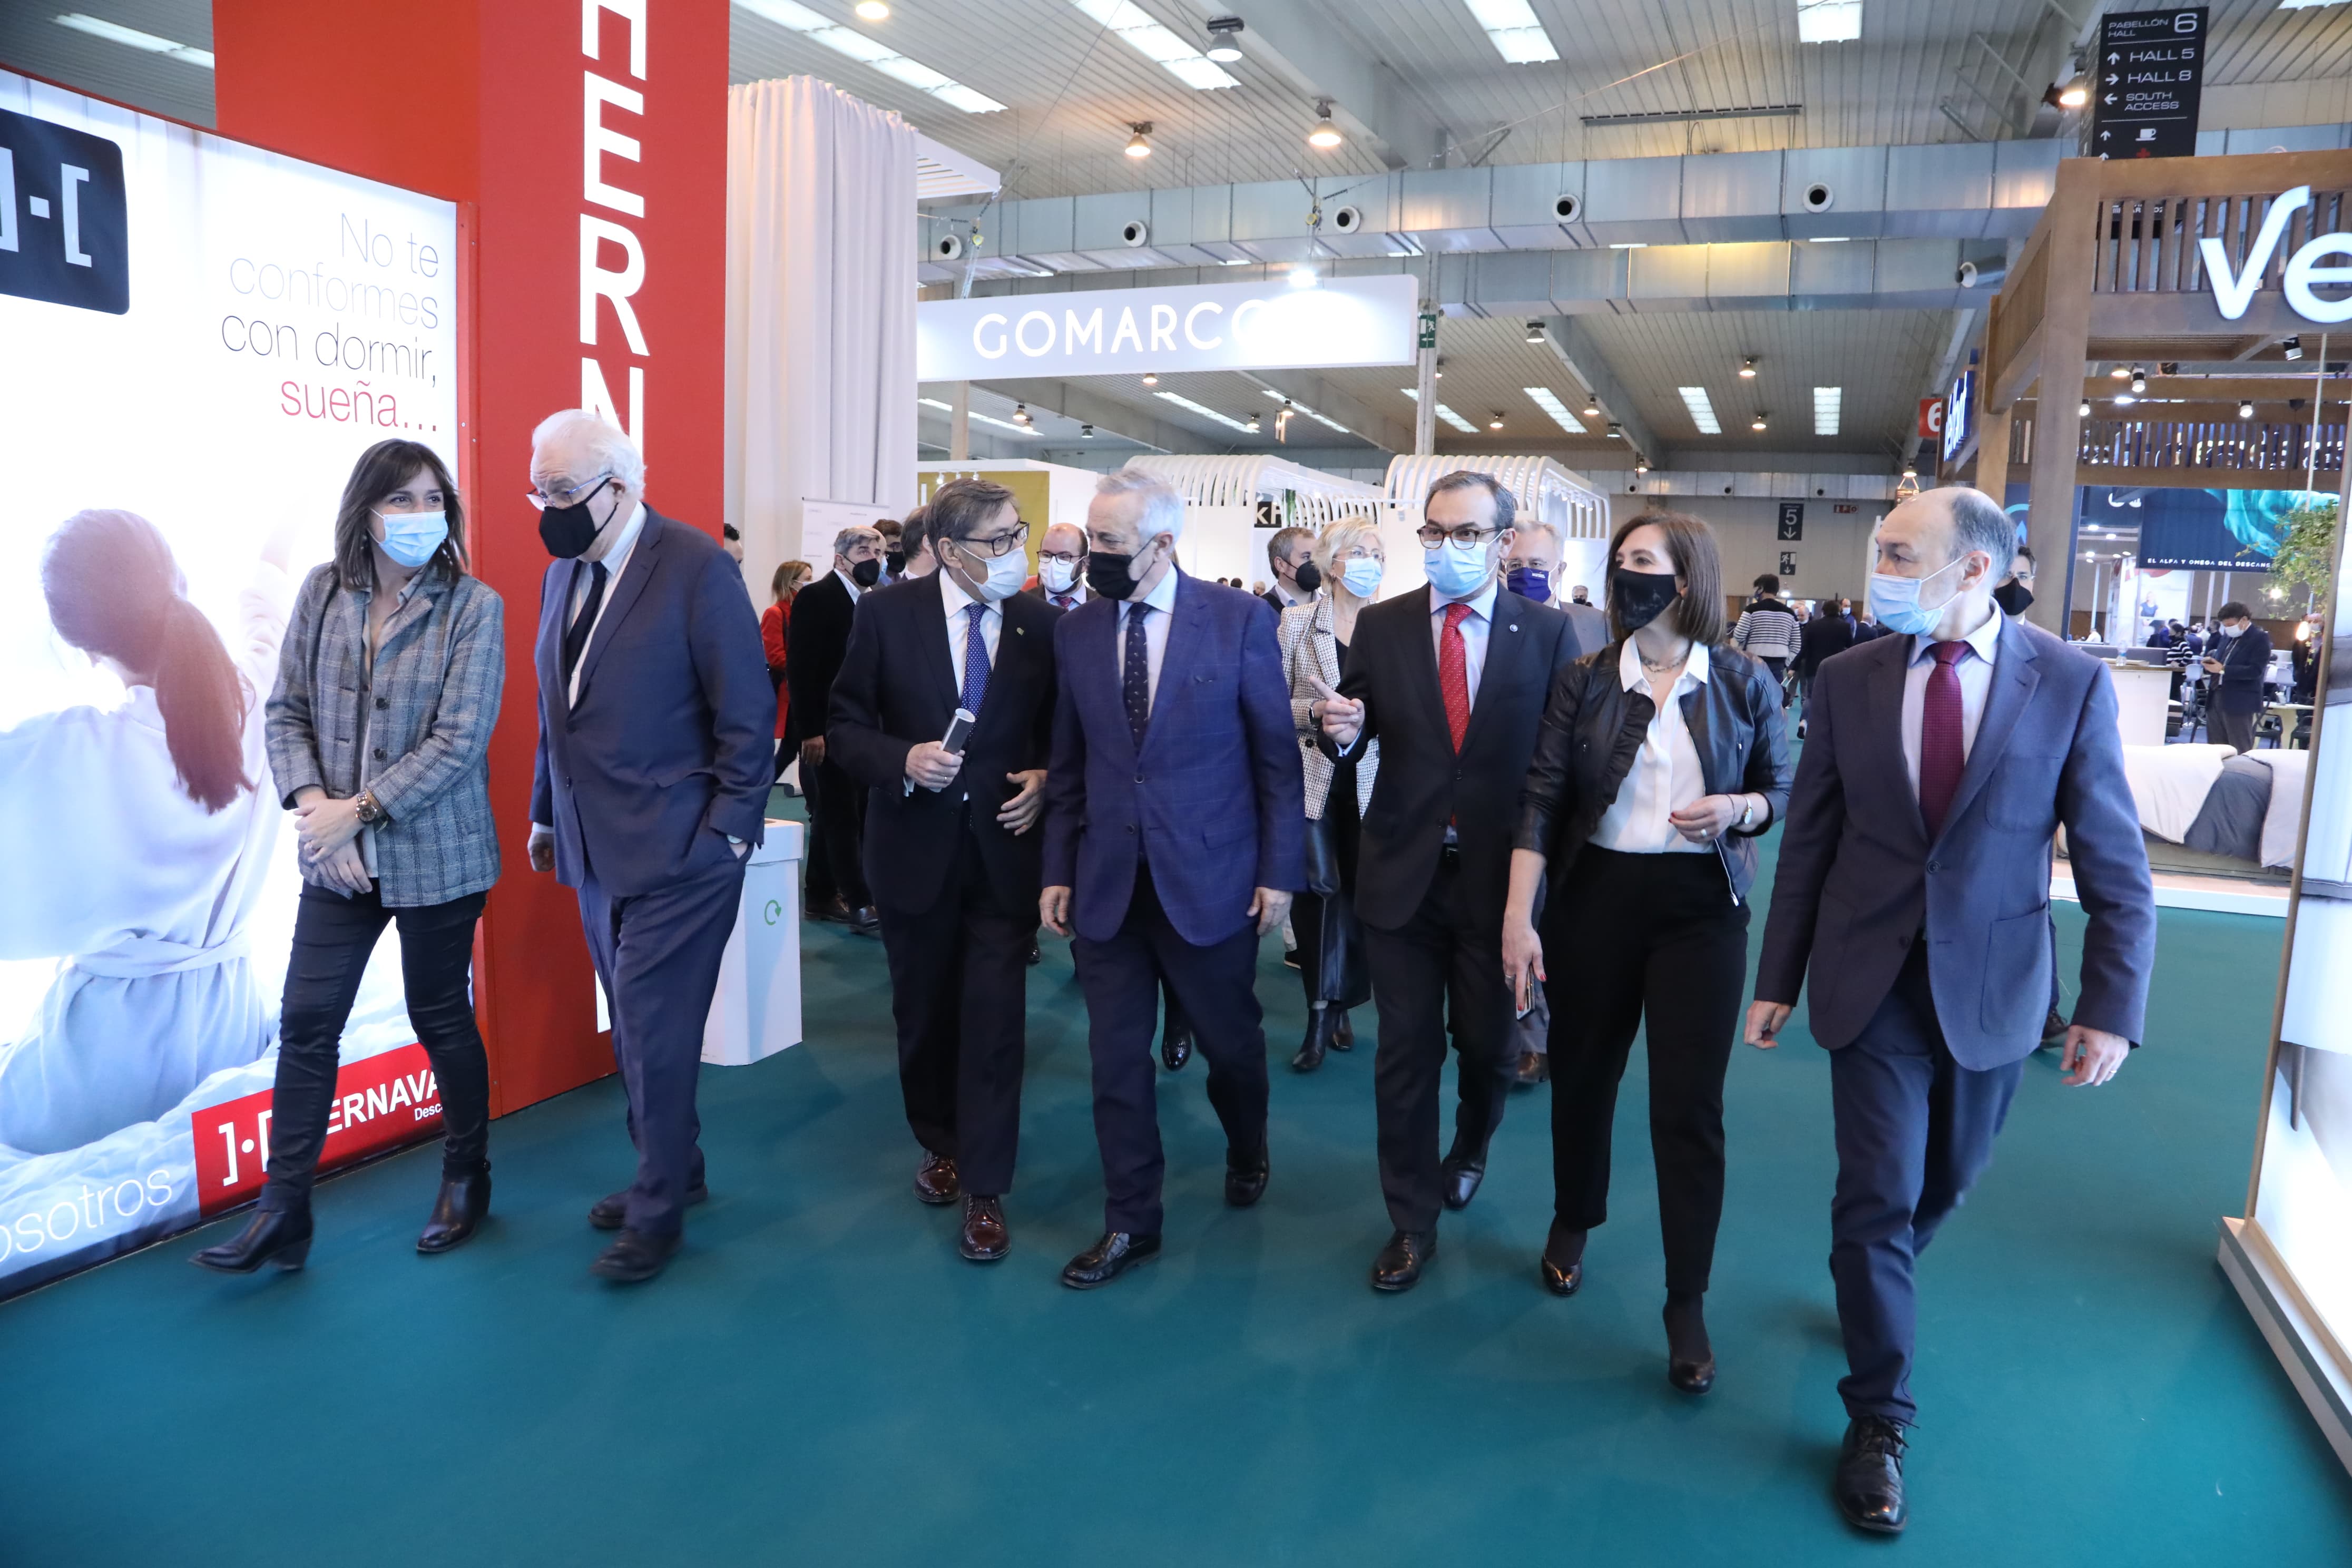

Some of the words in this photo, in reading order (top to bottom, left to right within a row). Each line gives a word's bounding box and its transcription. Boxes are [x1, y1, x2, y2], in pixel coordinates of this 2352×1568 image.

[2109, 18, 2169, 29] PABELLÓN
[2174, 13, 2198, 33] 6
[2130, 50, 2178, 62] HALL
[2181, 48, 2195, 60] 5
[2128, 72, 2175, 84] HALL
[2179, 70, 2192, 81] 8
[2124, 101, 2180, 111] ACCESS
[2126, 92, 2172, 102] SOUTH
[341, 212, 393, 267] No
[407, 232, 438, 278] te
[230, 258, 438, 329] conformes
[222, 315, 298, 360] con
[316, 322, 436, 388] dormir,
[281, 380, 436, 432] sueña...
[1927, 401, 1942, 433] 6
[1785, 509, 1797, 525] 5
[414, 1103, 443, 1121] Desc
